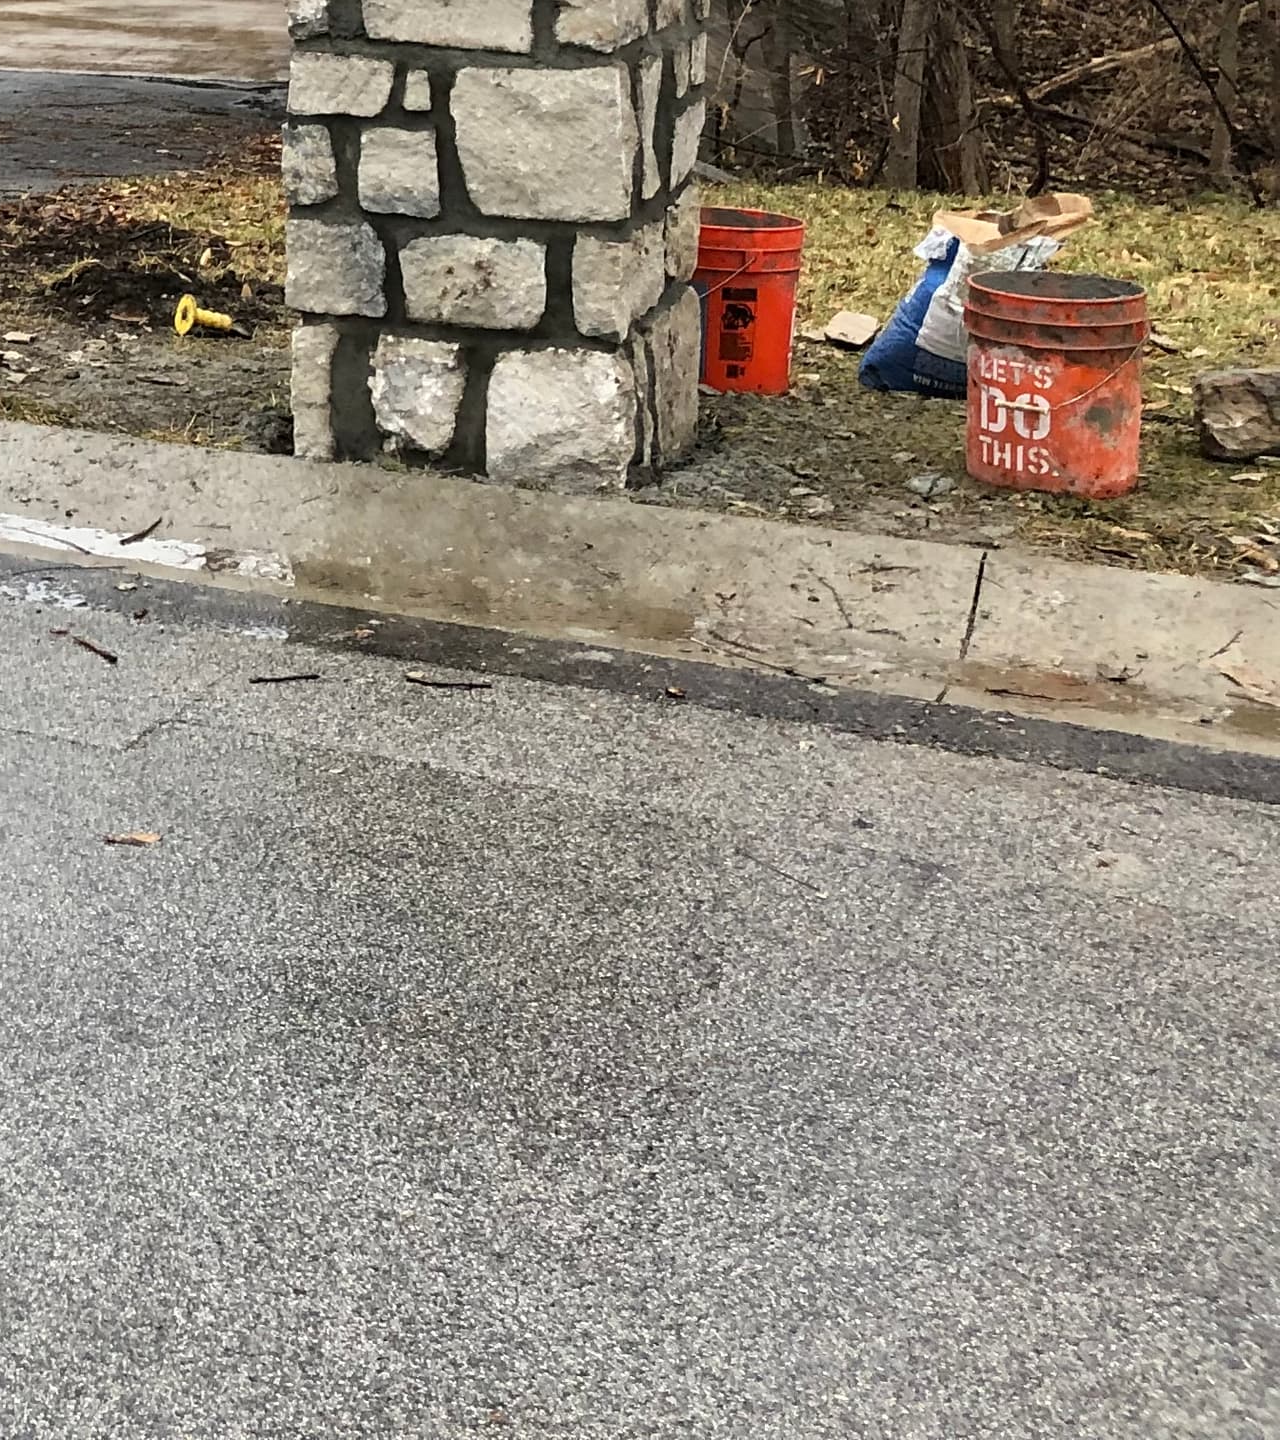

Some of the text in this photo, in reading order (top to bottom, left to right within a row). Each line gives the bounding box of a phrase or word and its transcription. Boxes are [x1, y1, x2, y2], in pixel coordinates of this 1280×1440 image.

[980, 354, 1054, 389] LET'S
[980, 383, 1051, 440] DO
[978, 434, 1060, 477] THIS.
